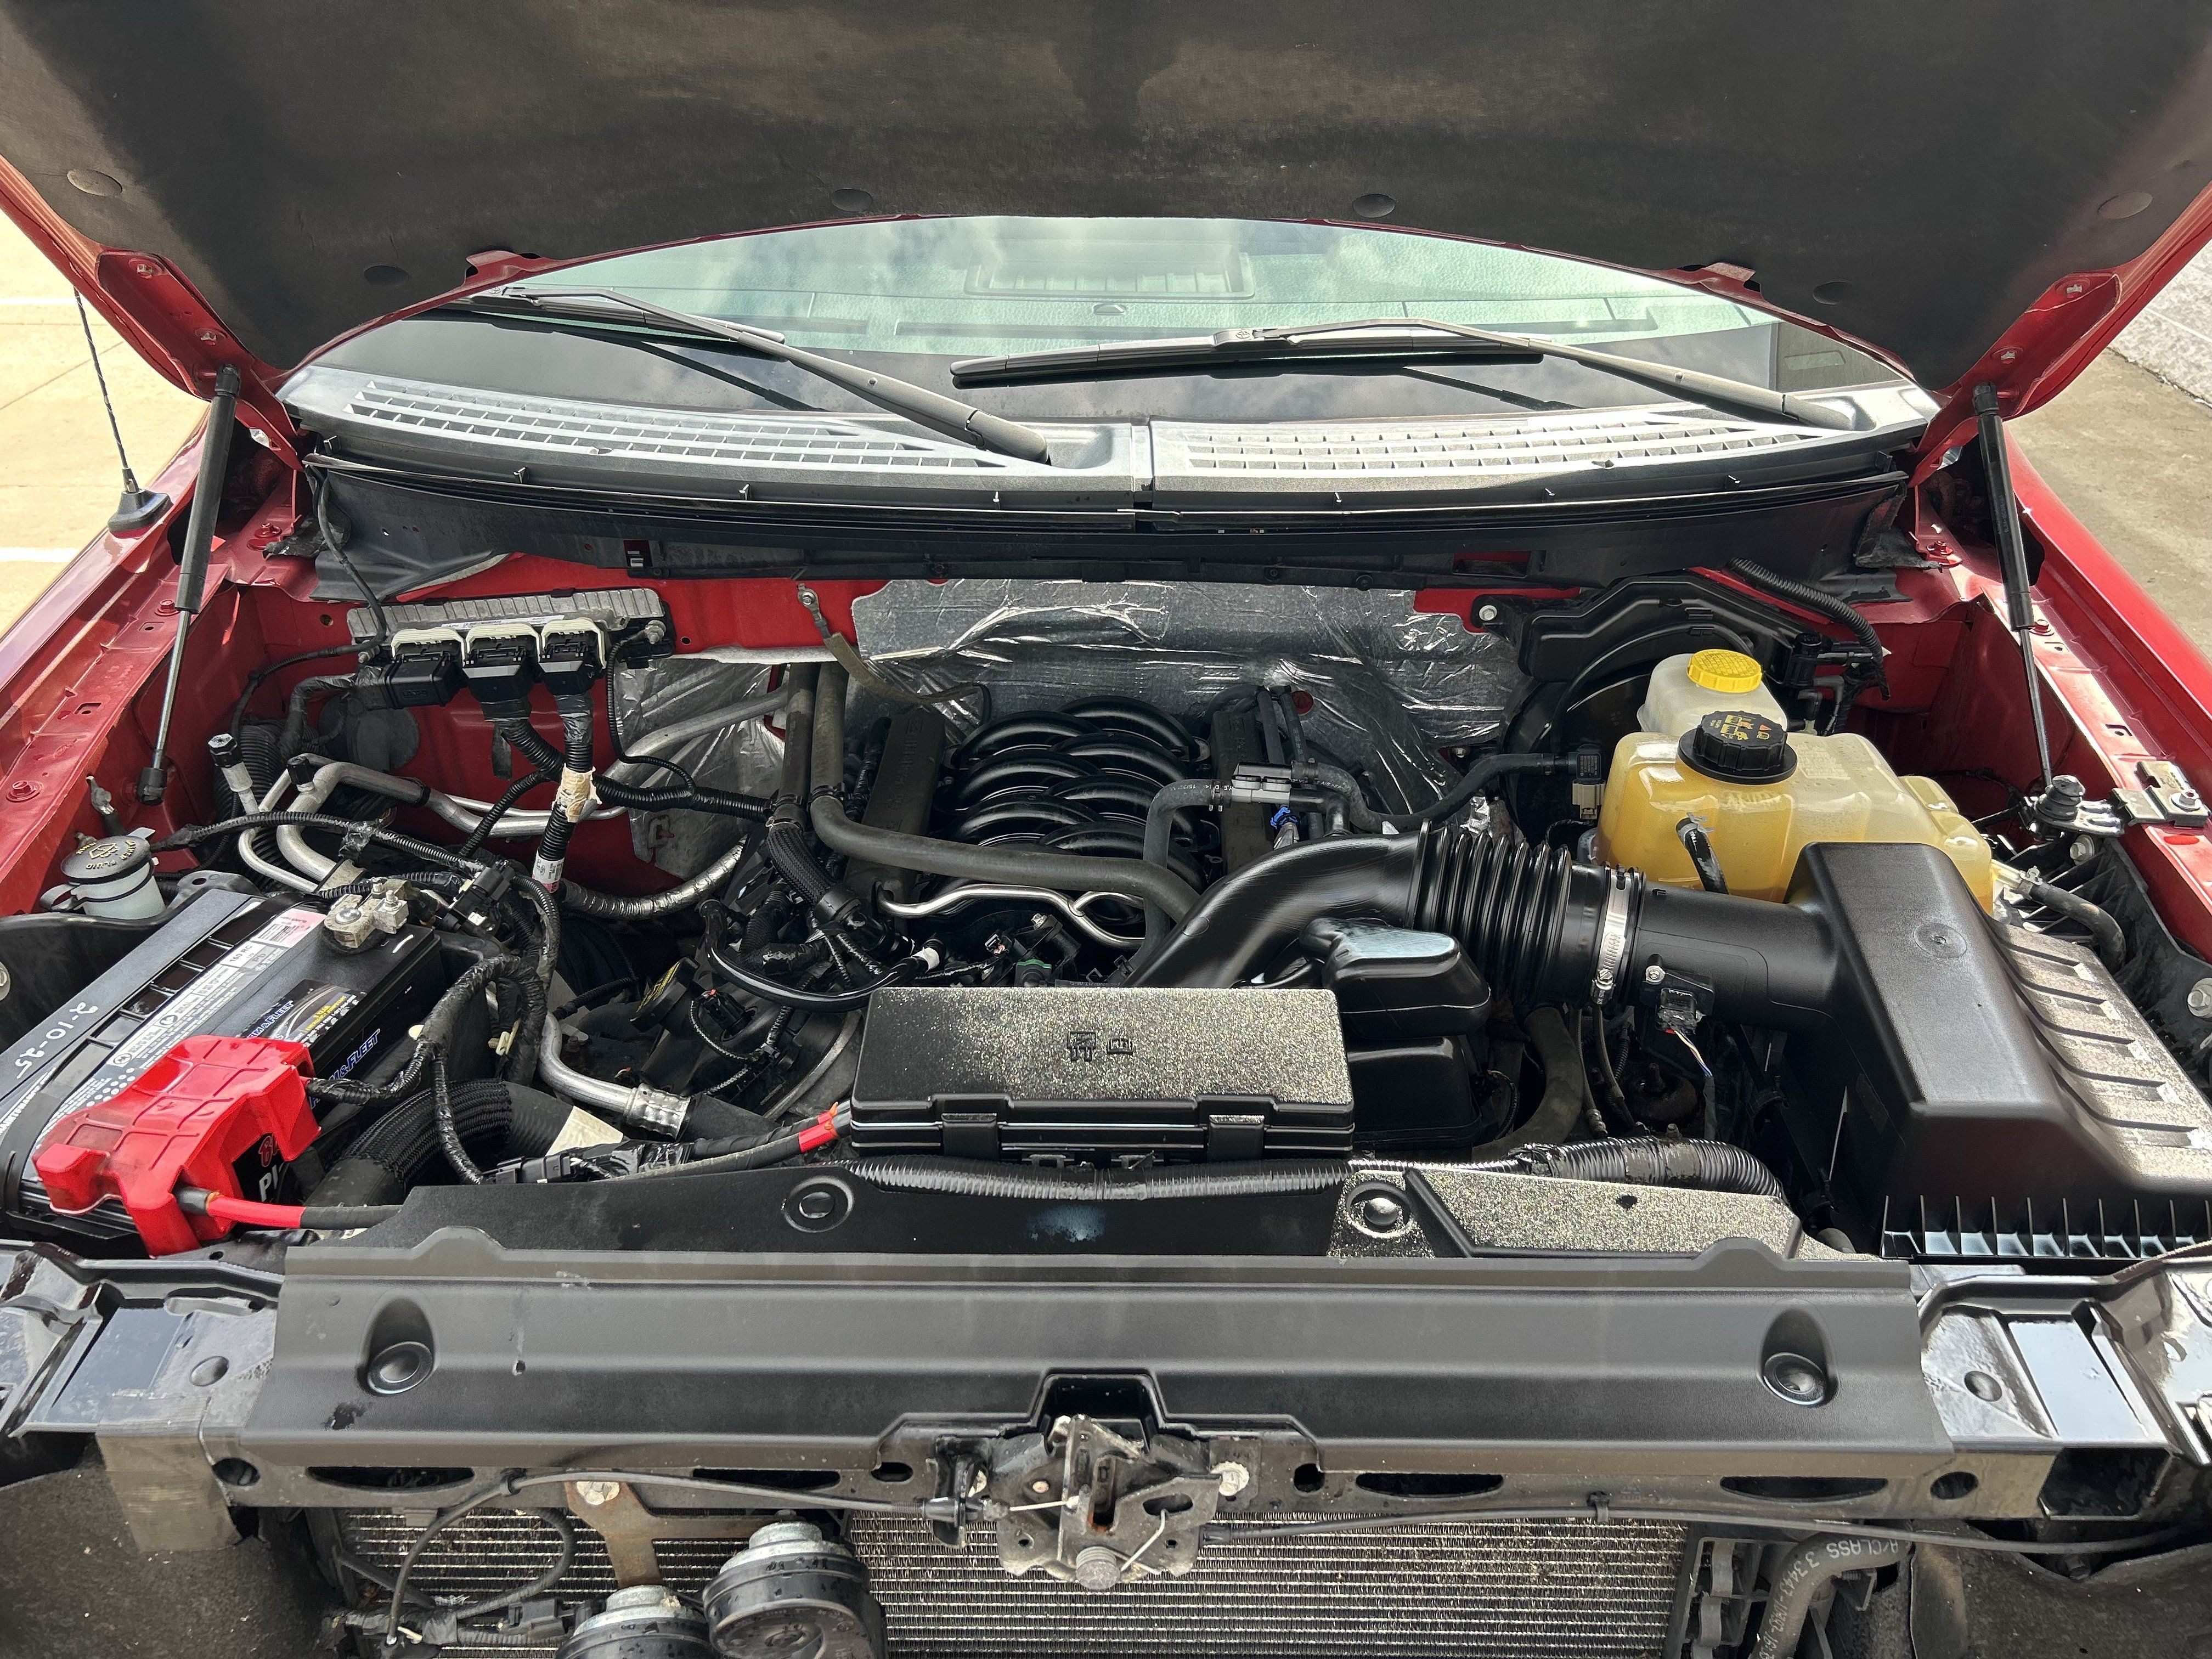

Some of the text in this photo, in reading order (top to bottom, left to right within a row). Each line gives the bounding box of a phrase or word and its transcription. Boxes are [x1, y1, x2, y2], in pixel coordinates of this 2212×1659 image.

[86, 860, 116, 870] FLUID
[241, 944, 252, 953] RC
[252, 952, 266, 961] Pb
[16, 1002, 98, 1079] 2-10-25
